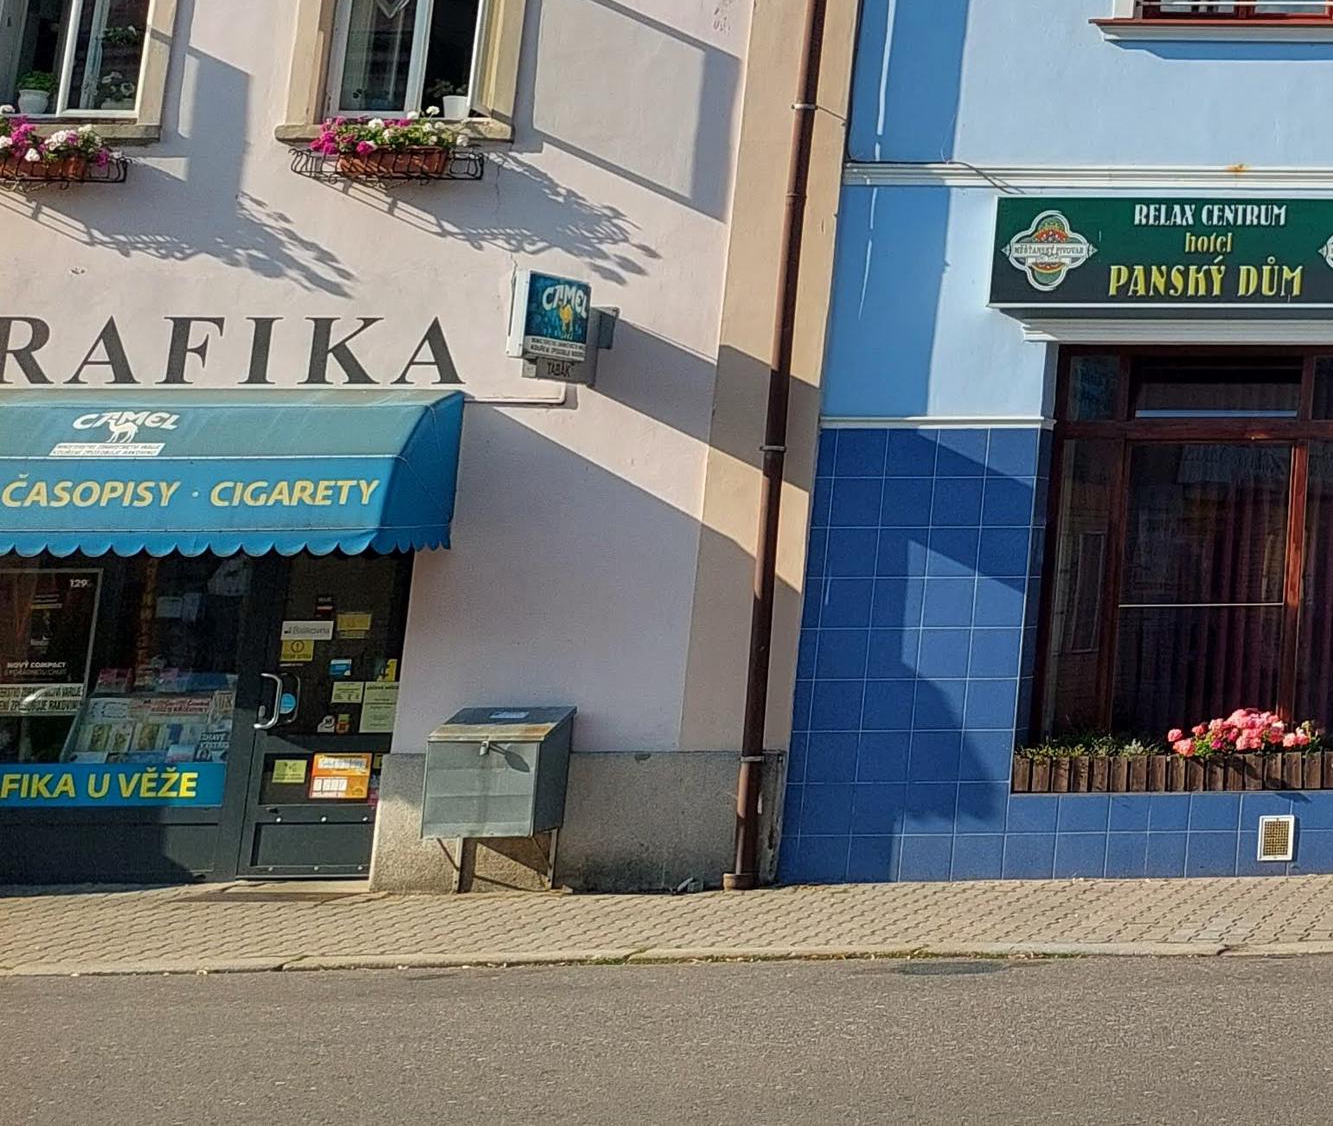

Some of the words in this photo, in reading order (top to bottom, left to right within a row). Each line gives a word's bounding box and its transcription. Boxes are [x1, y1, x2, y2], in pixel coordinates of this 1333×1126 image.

[1134, 204, 1195, 226] RELAX
[1201, 204, 1287, 226] CENTRUM
[1185, 232, 1233, 253] hotel
[1108, 255, 1226, 297] PANSKÝ
[1237, 256, 1304, 297] DŮM
[542, 284, 587, 319] CAMEL
[0, 315, 467, 386] RAFIKA
[72, 411, 180, 430] CAMEL
[1, 473, 182, 508] ČASOPISY
[210, 479, 380, 507] CIGARETY
[0, 773, 76, 799] FIKA
[88, 773, 111, 798] U
[118, 766, 199, 798] VĚŽE
